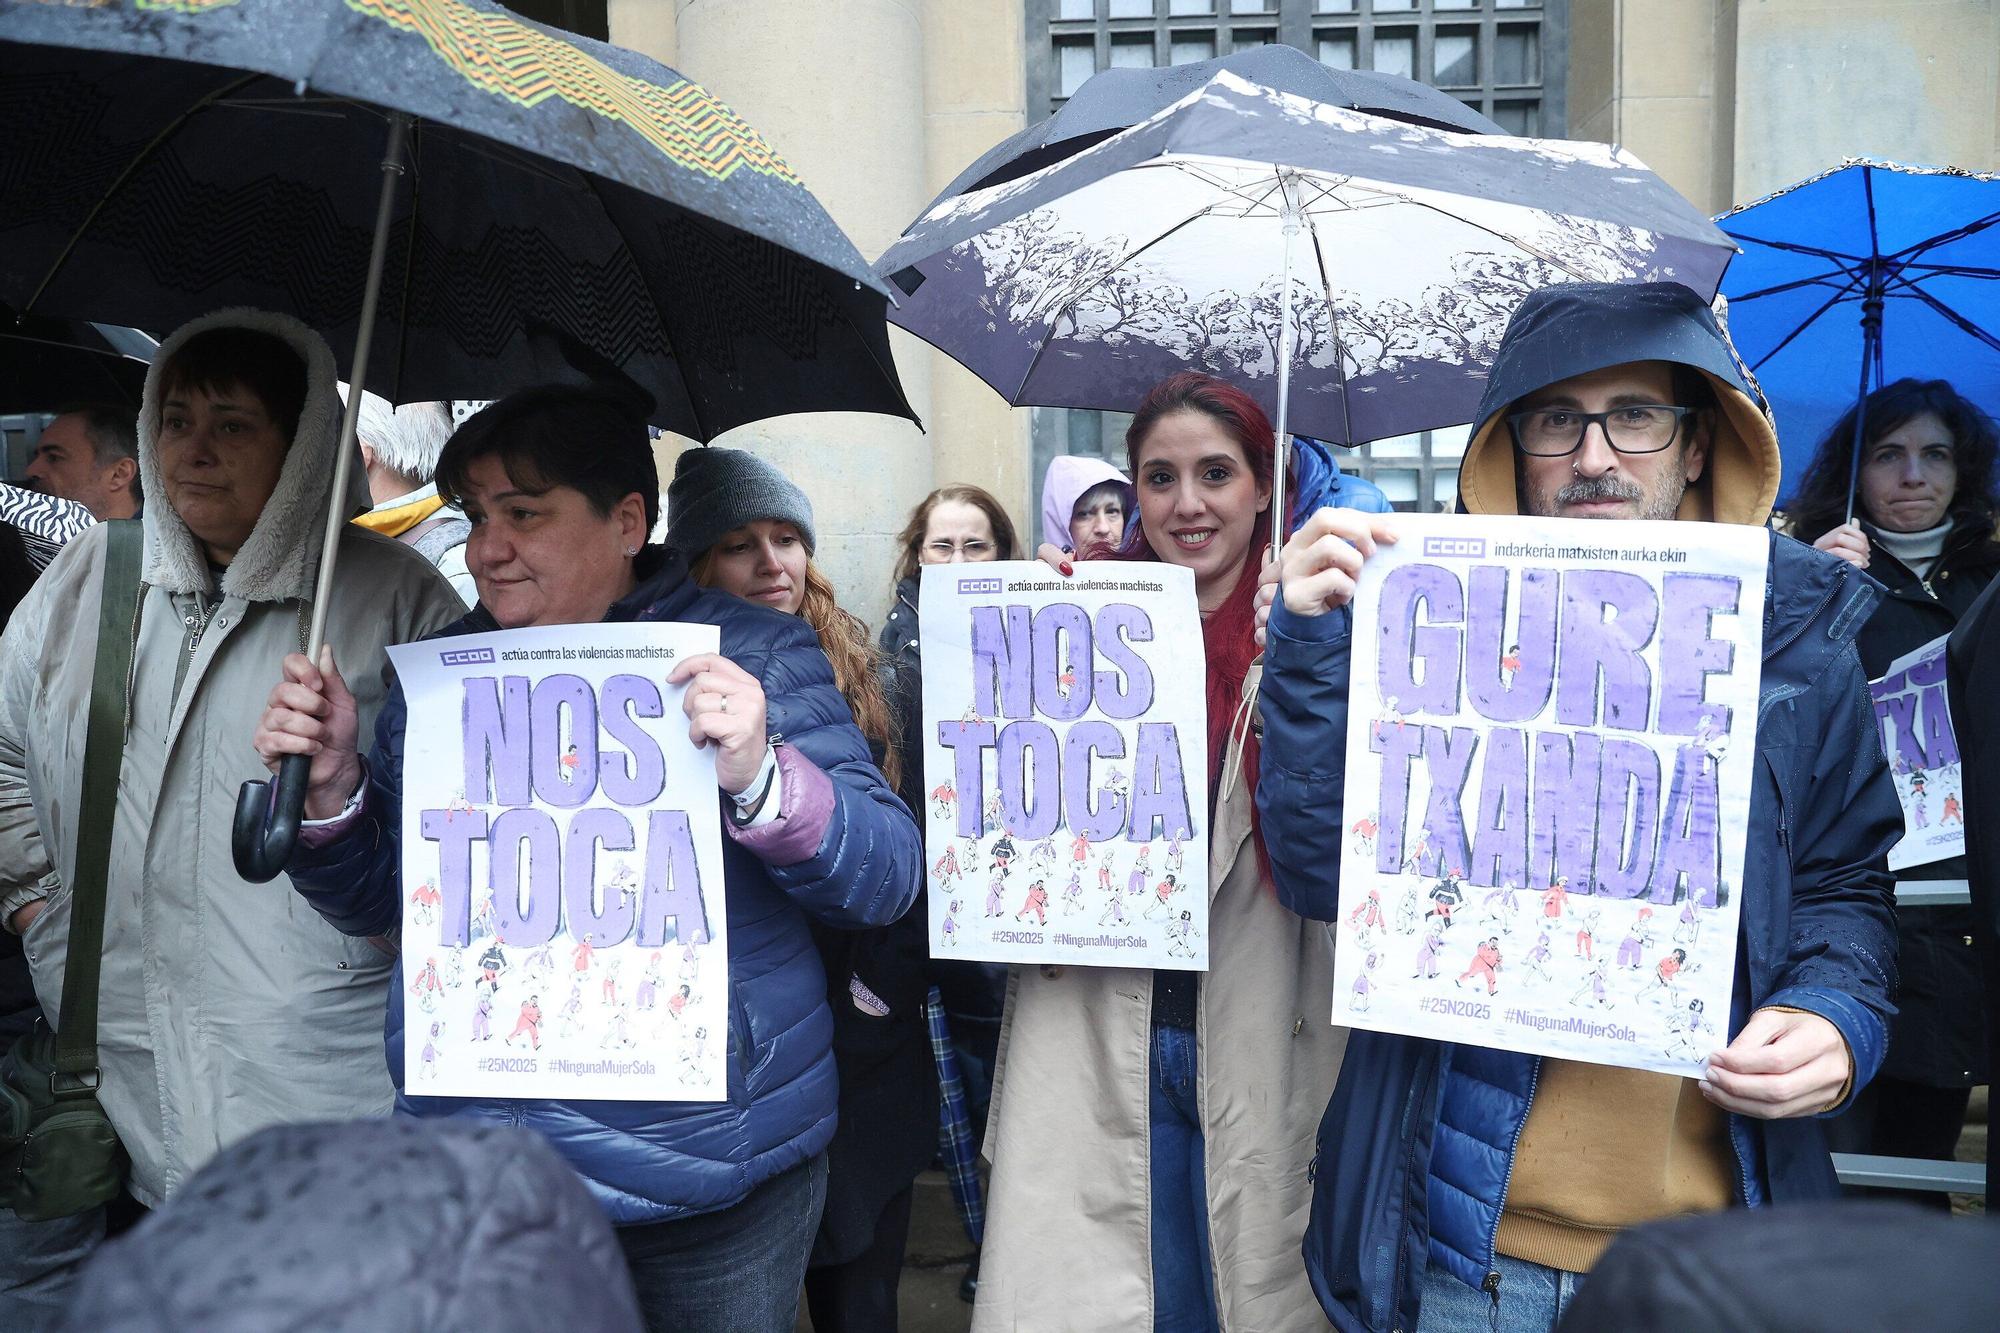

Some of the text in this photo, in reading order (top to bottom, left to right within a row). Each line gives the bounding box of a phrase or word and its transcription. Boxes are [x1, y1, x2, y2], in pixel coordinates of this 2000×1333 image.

[1426, 539, 1483, 556] CCOO
[1494, 542, 1687, 563] indarkeria matxisten aurka ekin
[959, 580, 1000, 593] CCOO
[1008, 579, 1163, 592] actúa contra las violencias machistas
[443, 649, 494, 664] CCOO
[502, 646, 675, 661] actúa contra las violencias machistas
[1376, 563, 1742, 736] GURE
[971, 603, 1155, 721] NOS
[462, 674, 666, 806] NOS
[939, 720, 1194, 842] TOCA
[1369, 718, 1723, 908] TXANDA
[421, 808, 711, 947] TOCA
[991, 931, 1148, 949] #25N2025 #NingunaMujerSola
[1419, 997, 1636, 1043] #25N2025 #NingunaMujerSola
[478, 1058, 656, 1078] #25N2025 #NingunaMujerSola
